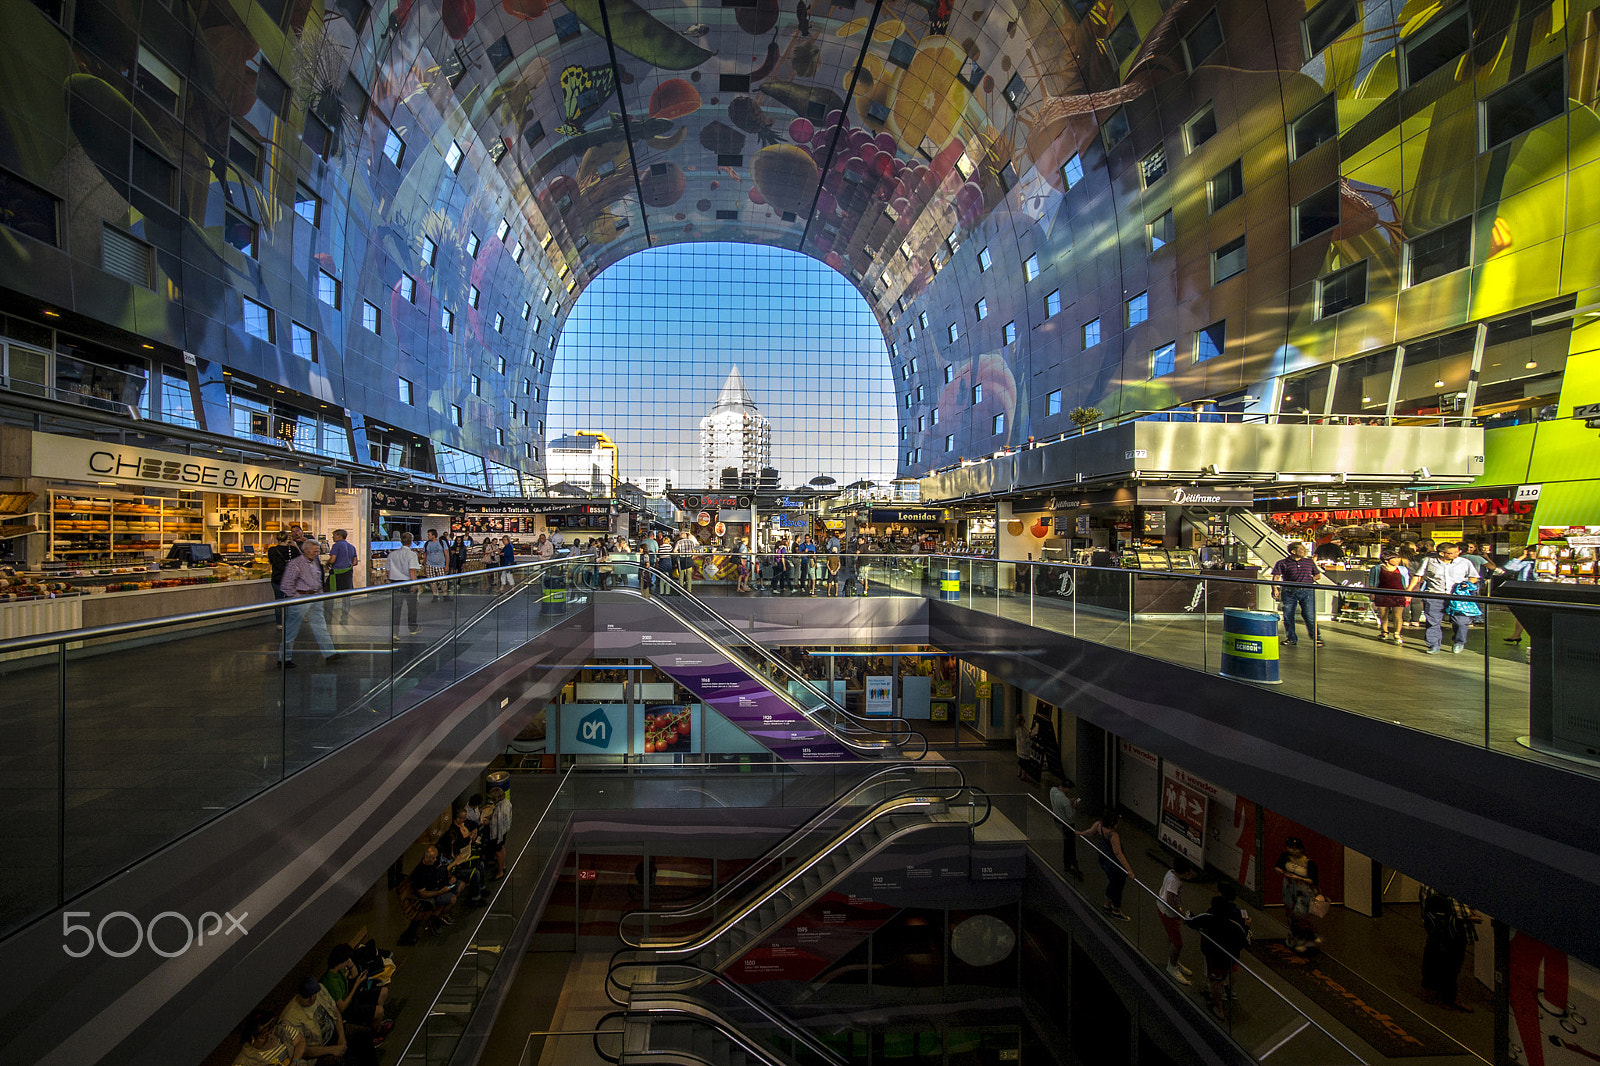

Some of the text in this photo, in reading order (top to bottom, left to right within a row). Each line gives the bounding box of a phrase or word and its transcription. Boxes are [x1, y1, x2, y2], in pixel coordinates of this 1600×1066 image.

[89, 451, 301, 494] CHEESE & MORE
[700, 495, 737, 506] Churros
[1519, 489, 1538, 497] 110
[898, 512, 937, 521] Leonidas
[1388, 501, 1444, 518] NAM
[1450, 497, 1532, 517] HONG
[1133, 745, 1157, 763] vendor
[1187, 775, 1218, 795] vendor
